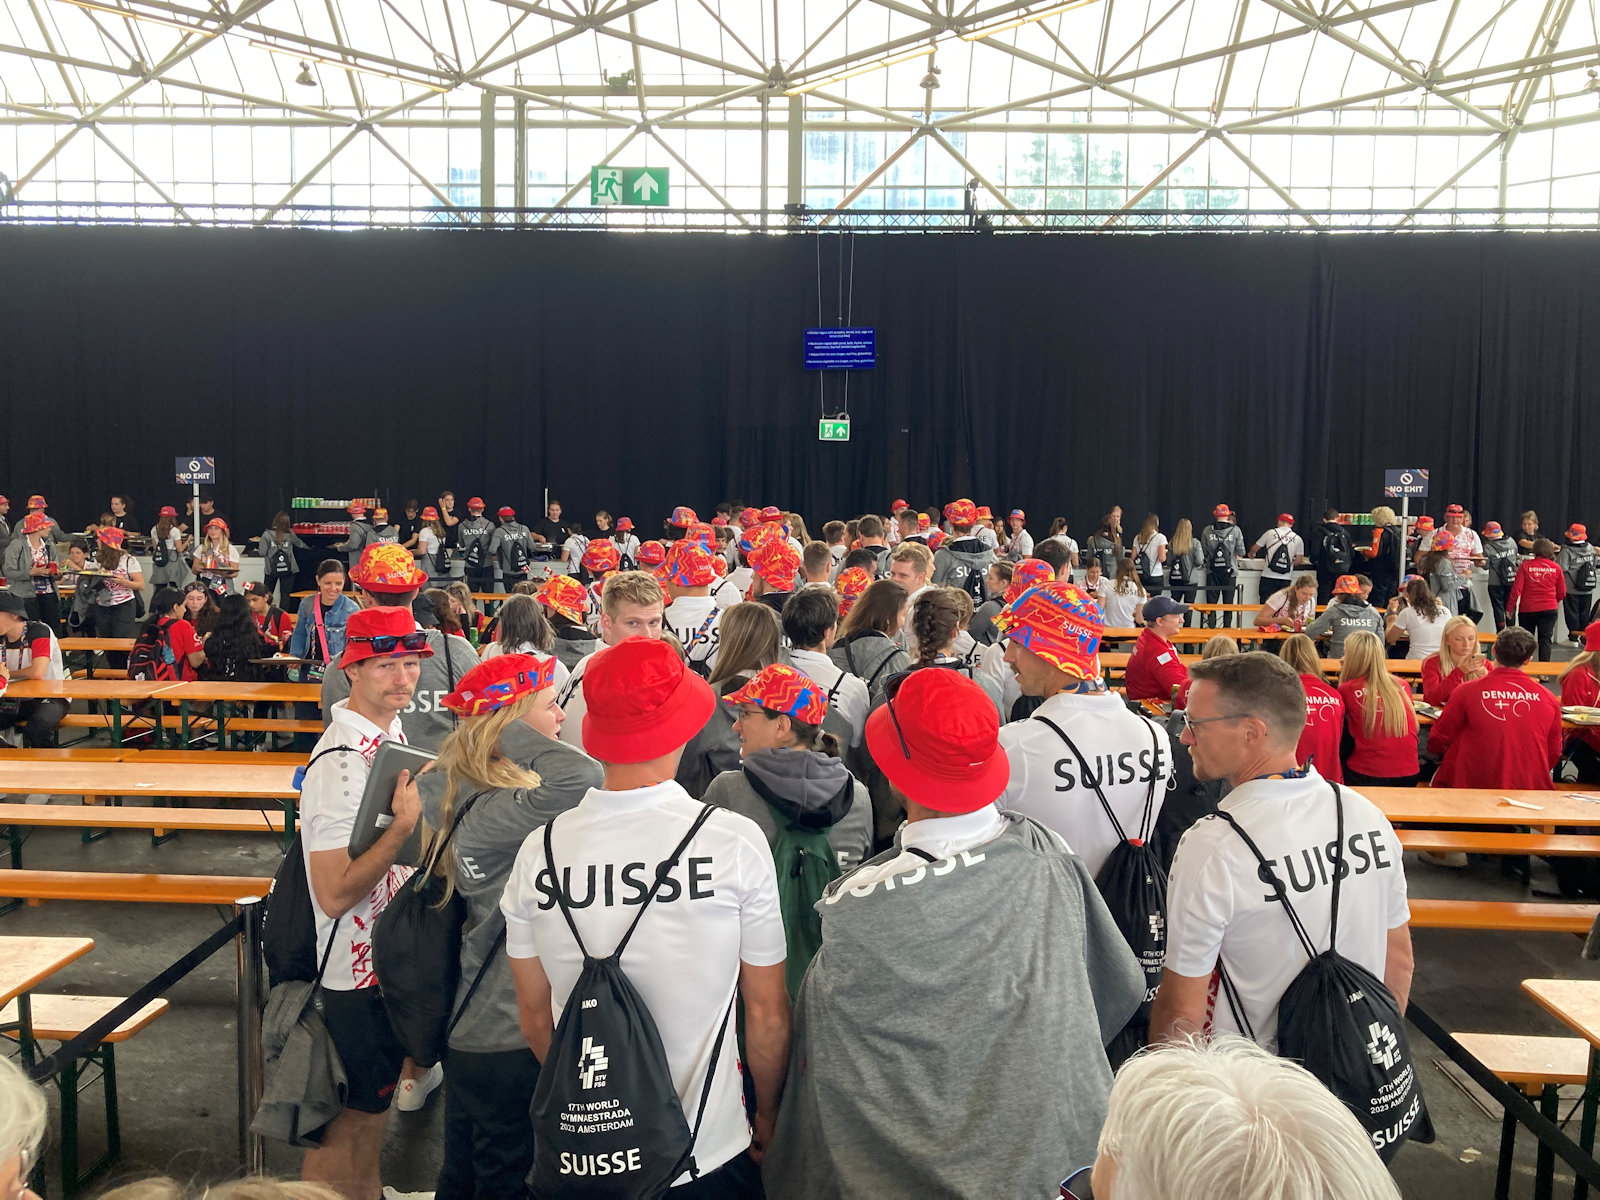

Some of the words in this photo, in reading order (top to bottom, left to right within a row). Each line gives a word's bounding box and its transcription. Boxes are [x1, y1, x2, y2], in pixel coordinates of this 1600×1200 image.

[1062, 620, 1094, 639] SUISSE
[1341, 618, 1372, 627] SUISSE
[1305, 696, 1341, 706] NMARK
[1482, 690, 1541, 702] DENMARK
[1054, 748, 1166, 792] SUISSE
[1257, 830, 1391, 902] SUISSE
[534, 856, 716, 911] SUISSE
[594, 1074, 607, 1082] STV
[568, 1103, 585, 1112] 17TH
[587, 1099, 620, 1111] WORLD
[1370, 1103, 1390, 1114] 2023
[560, 1108, 631, 1123] GYMNAESTRADA
[1373, 1093, 1420, 1150] SUISSE
[560, 1122, 576, 1133] 2023
[577, 1118, 634, 1134] AMSTERDAM
[560, 1148, 642, 1176] SUISSE
